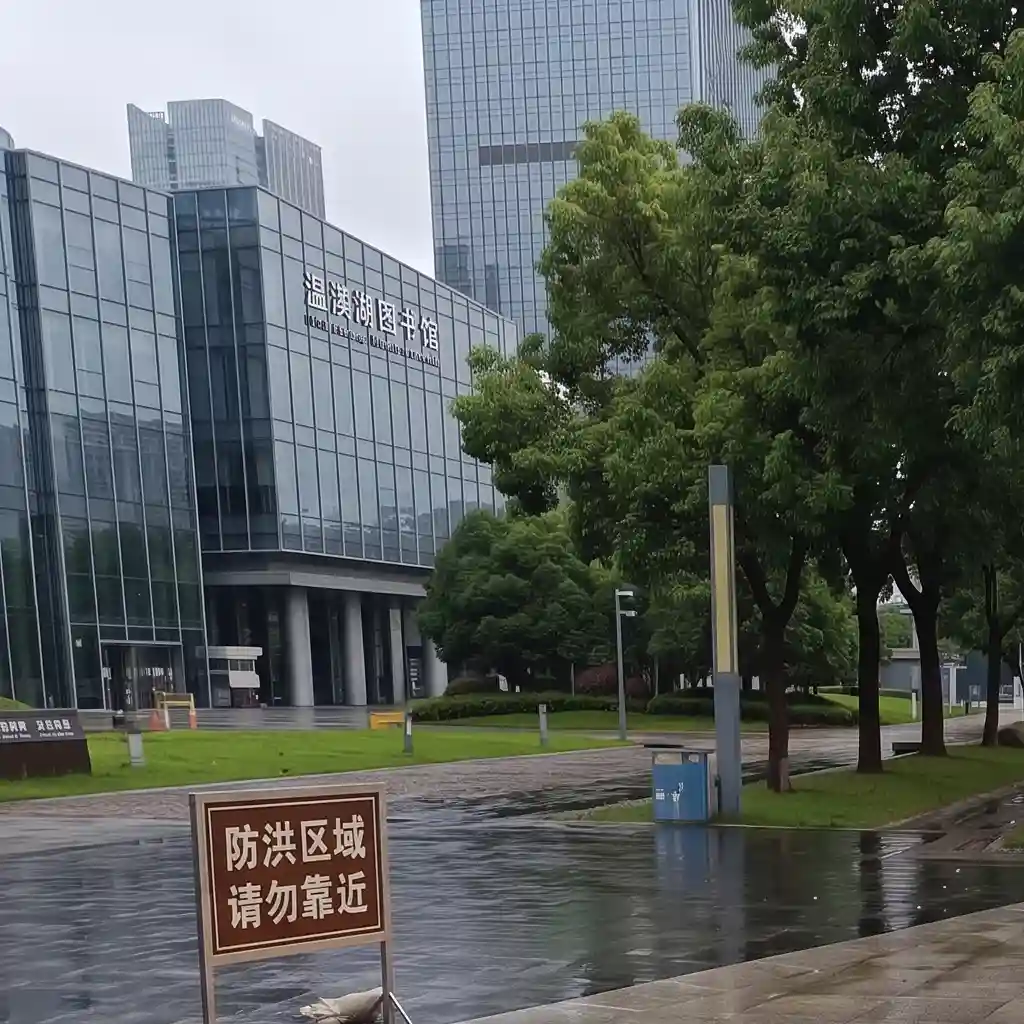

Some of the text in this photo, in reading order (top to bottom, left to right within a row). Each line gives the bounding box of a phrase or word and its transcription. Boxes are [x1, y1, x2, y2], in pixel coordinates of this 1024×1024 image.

[225, 814, 366, 871] 防洪区域
[227, 871, 368, 929] 请勿靠近
